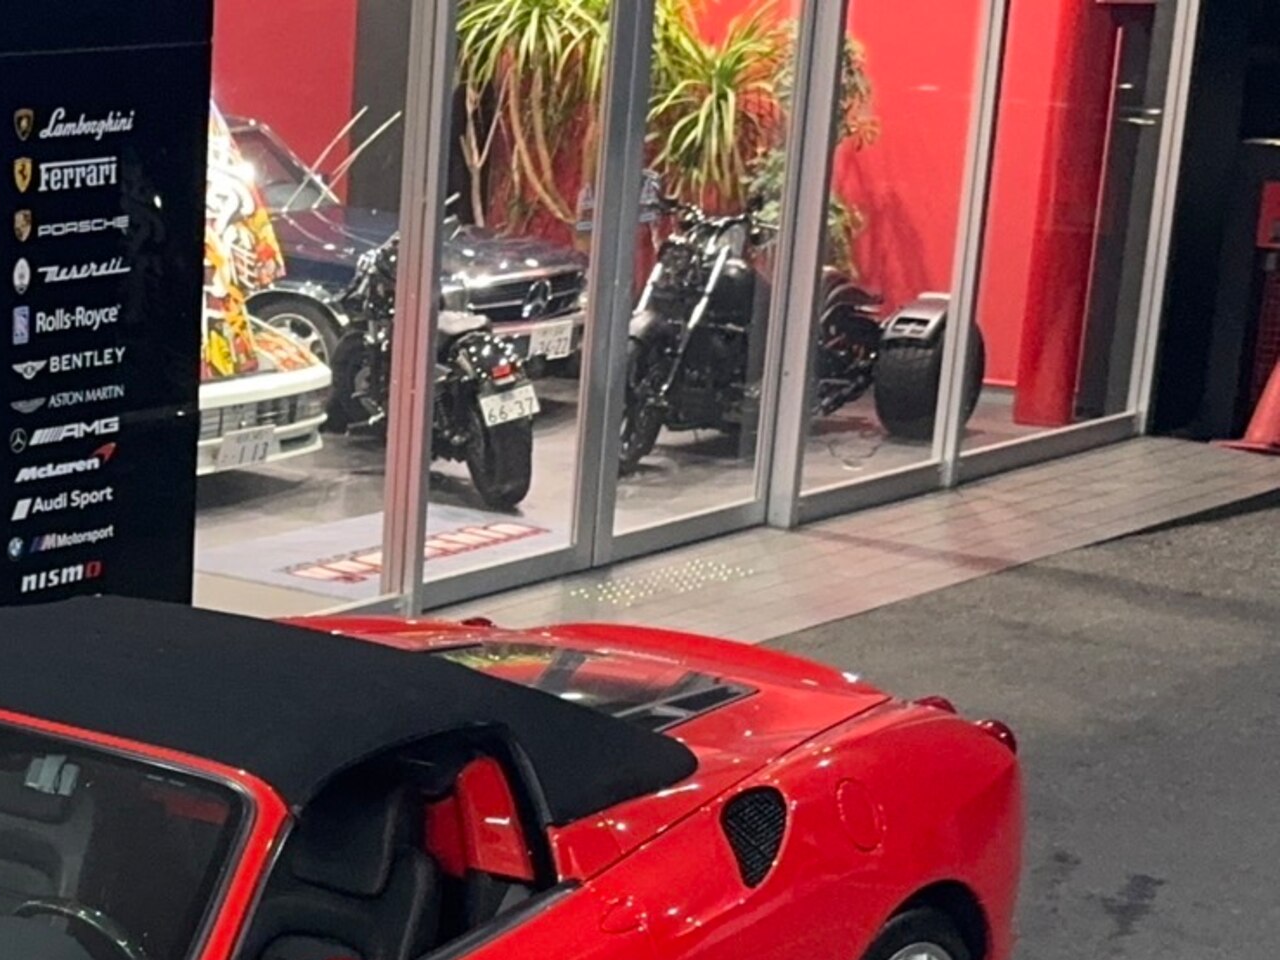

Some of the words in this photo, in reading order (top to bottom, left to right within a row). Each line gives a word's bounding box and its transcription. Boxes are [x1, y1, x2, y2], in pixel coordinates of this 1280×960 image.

[38, 107, 135, 141] Lamborghini
[38, 156, 117, 192] Ferrari
[38, 215, 130, 237] PORSCHE
[38, 257, 131, 283] Maserati
[36, 306, 119, 333] Rolls-Royce
[49, 346, 126, 373] BENTLEY
[47, 390, 84, 409] ASTON
[84, 383, 125, 402] MARTIN
[15, 457, 100, 483] McLaren
[32, 492, 68, 514] Audi
[70, 486, 114, 509] Sport
[57, 525, 114, 548] Motorsport
[21, 561, 102, 593] nismo
